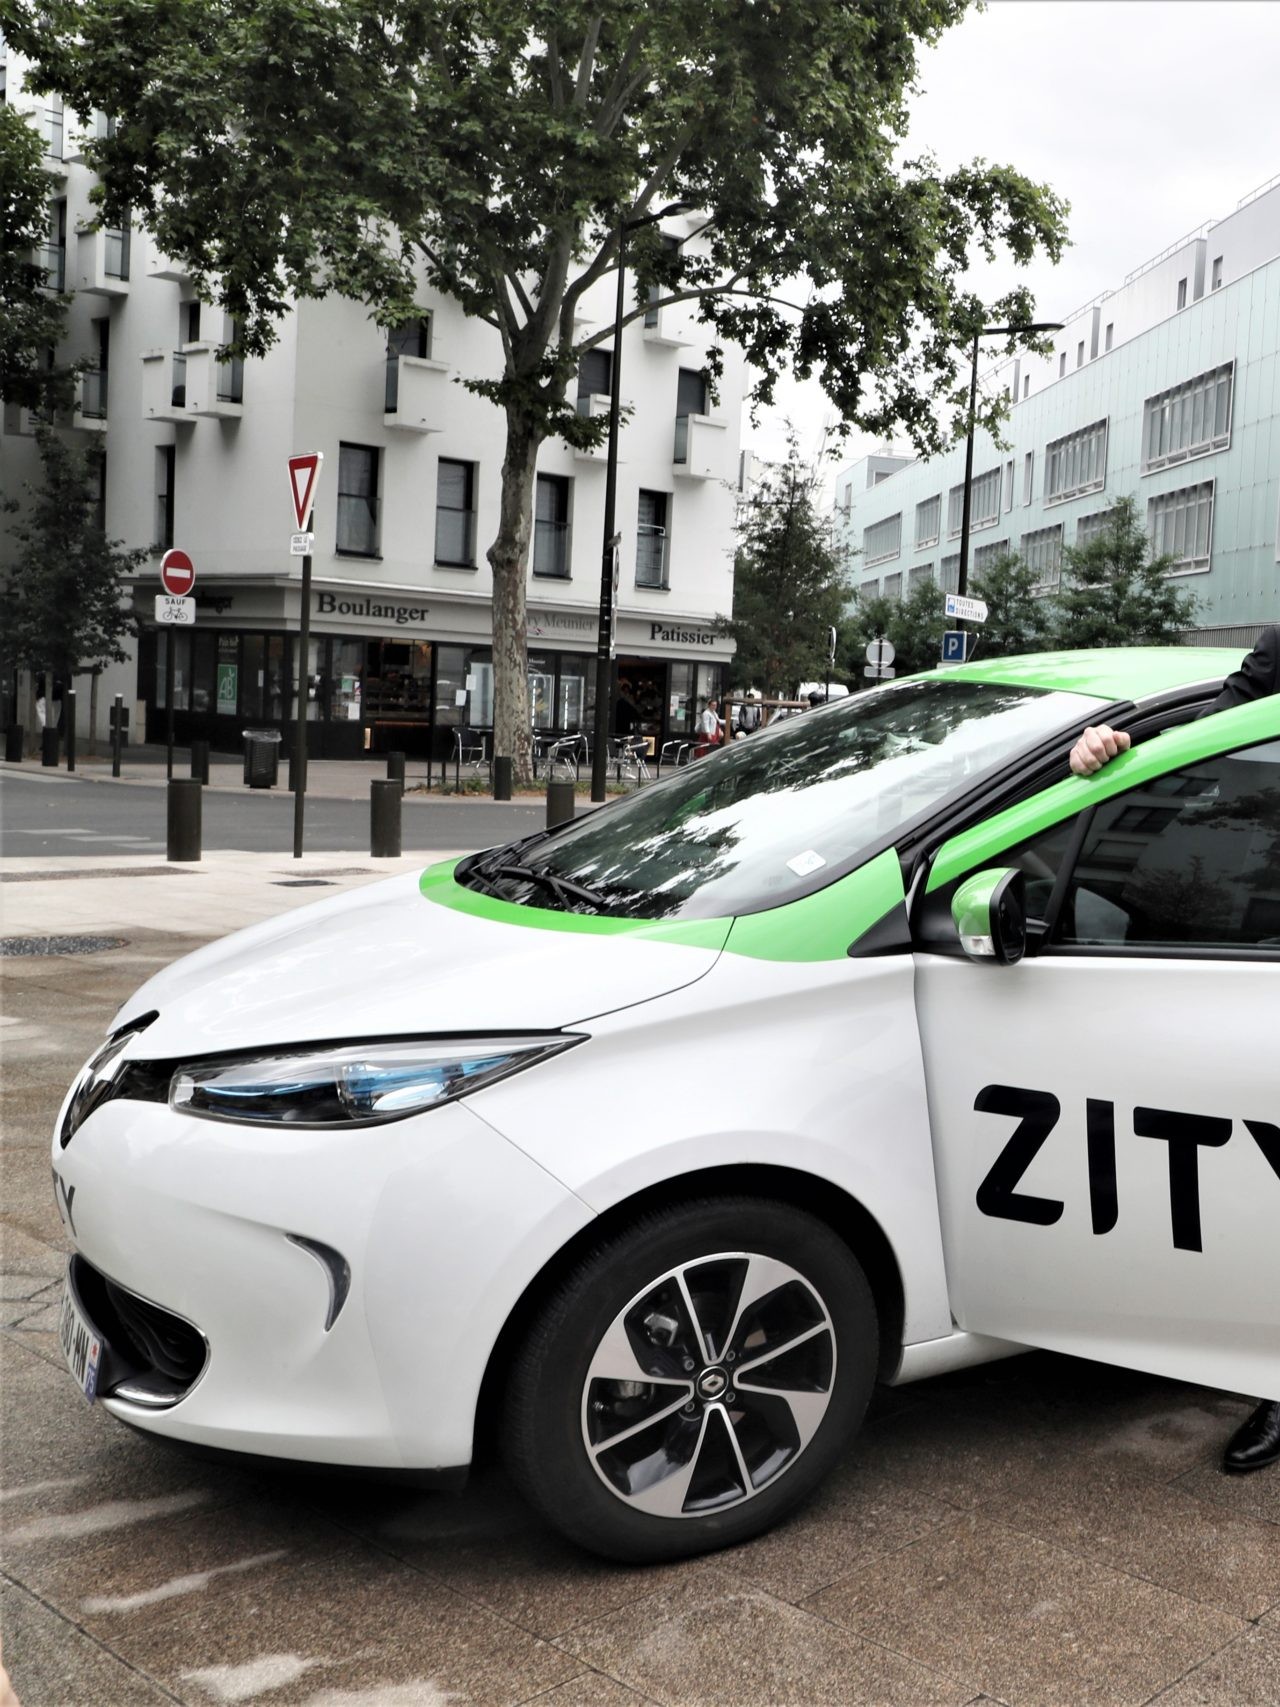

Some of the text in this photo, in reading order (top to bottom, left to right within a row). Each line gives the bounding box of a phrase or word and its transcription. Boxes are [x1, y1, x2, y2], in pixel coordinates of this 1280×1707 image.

[165, 597, 186, 606] SAUF
[317, 592, 429, 624] Boulanger
[650, 622, 717, 645] Patissier
[948, 637, 959, 656] P
